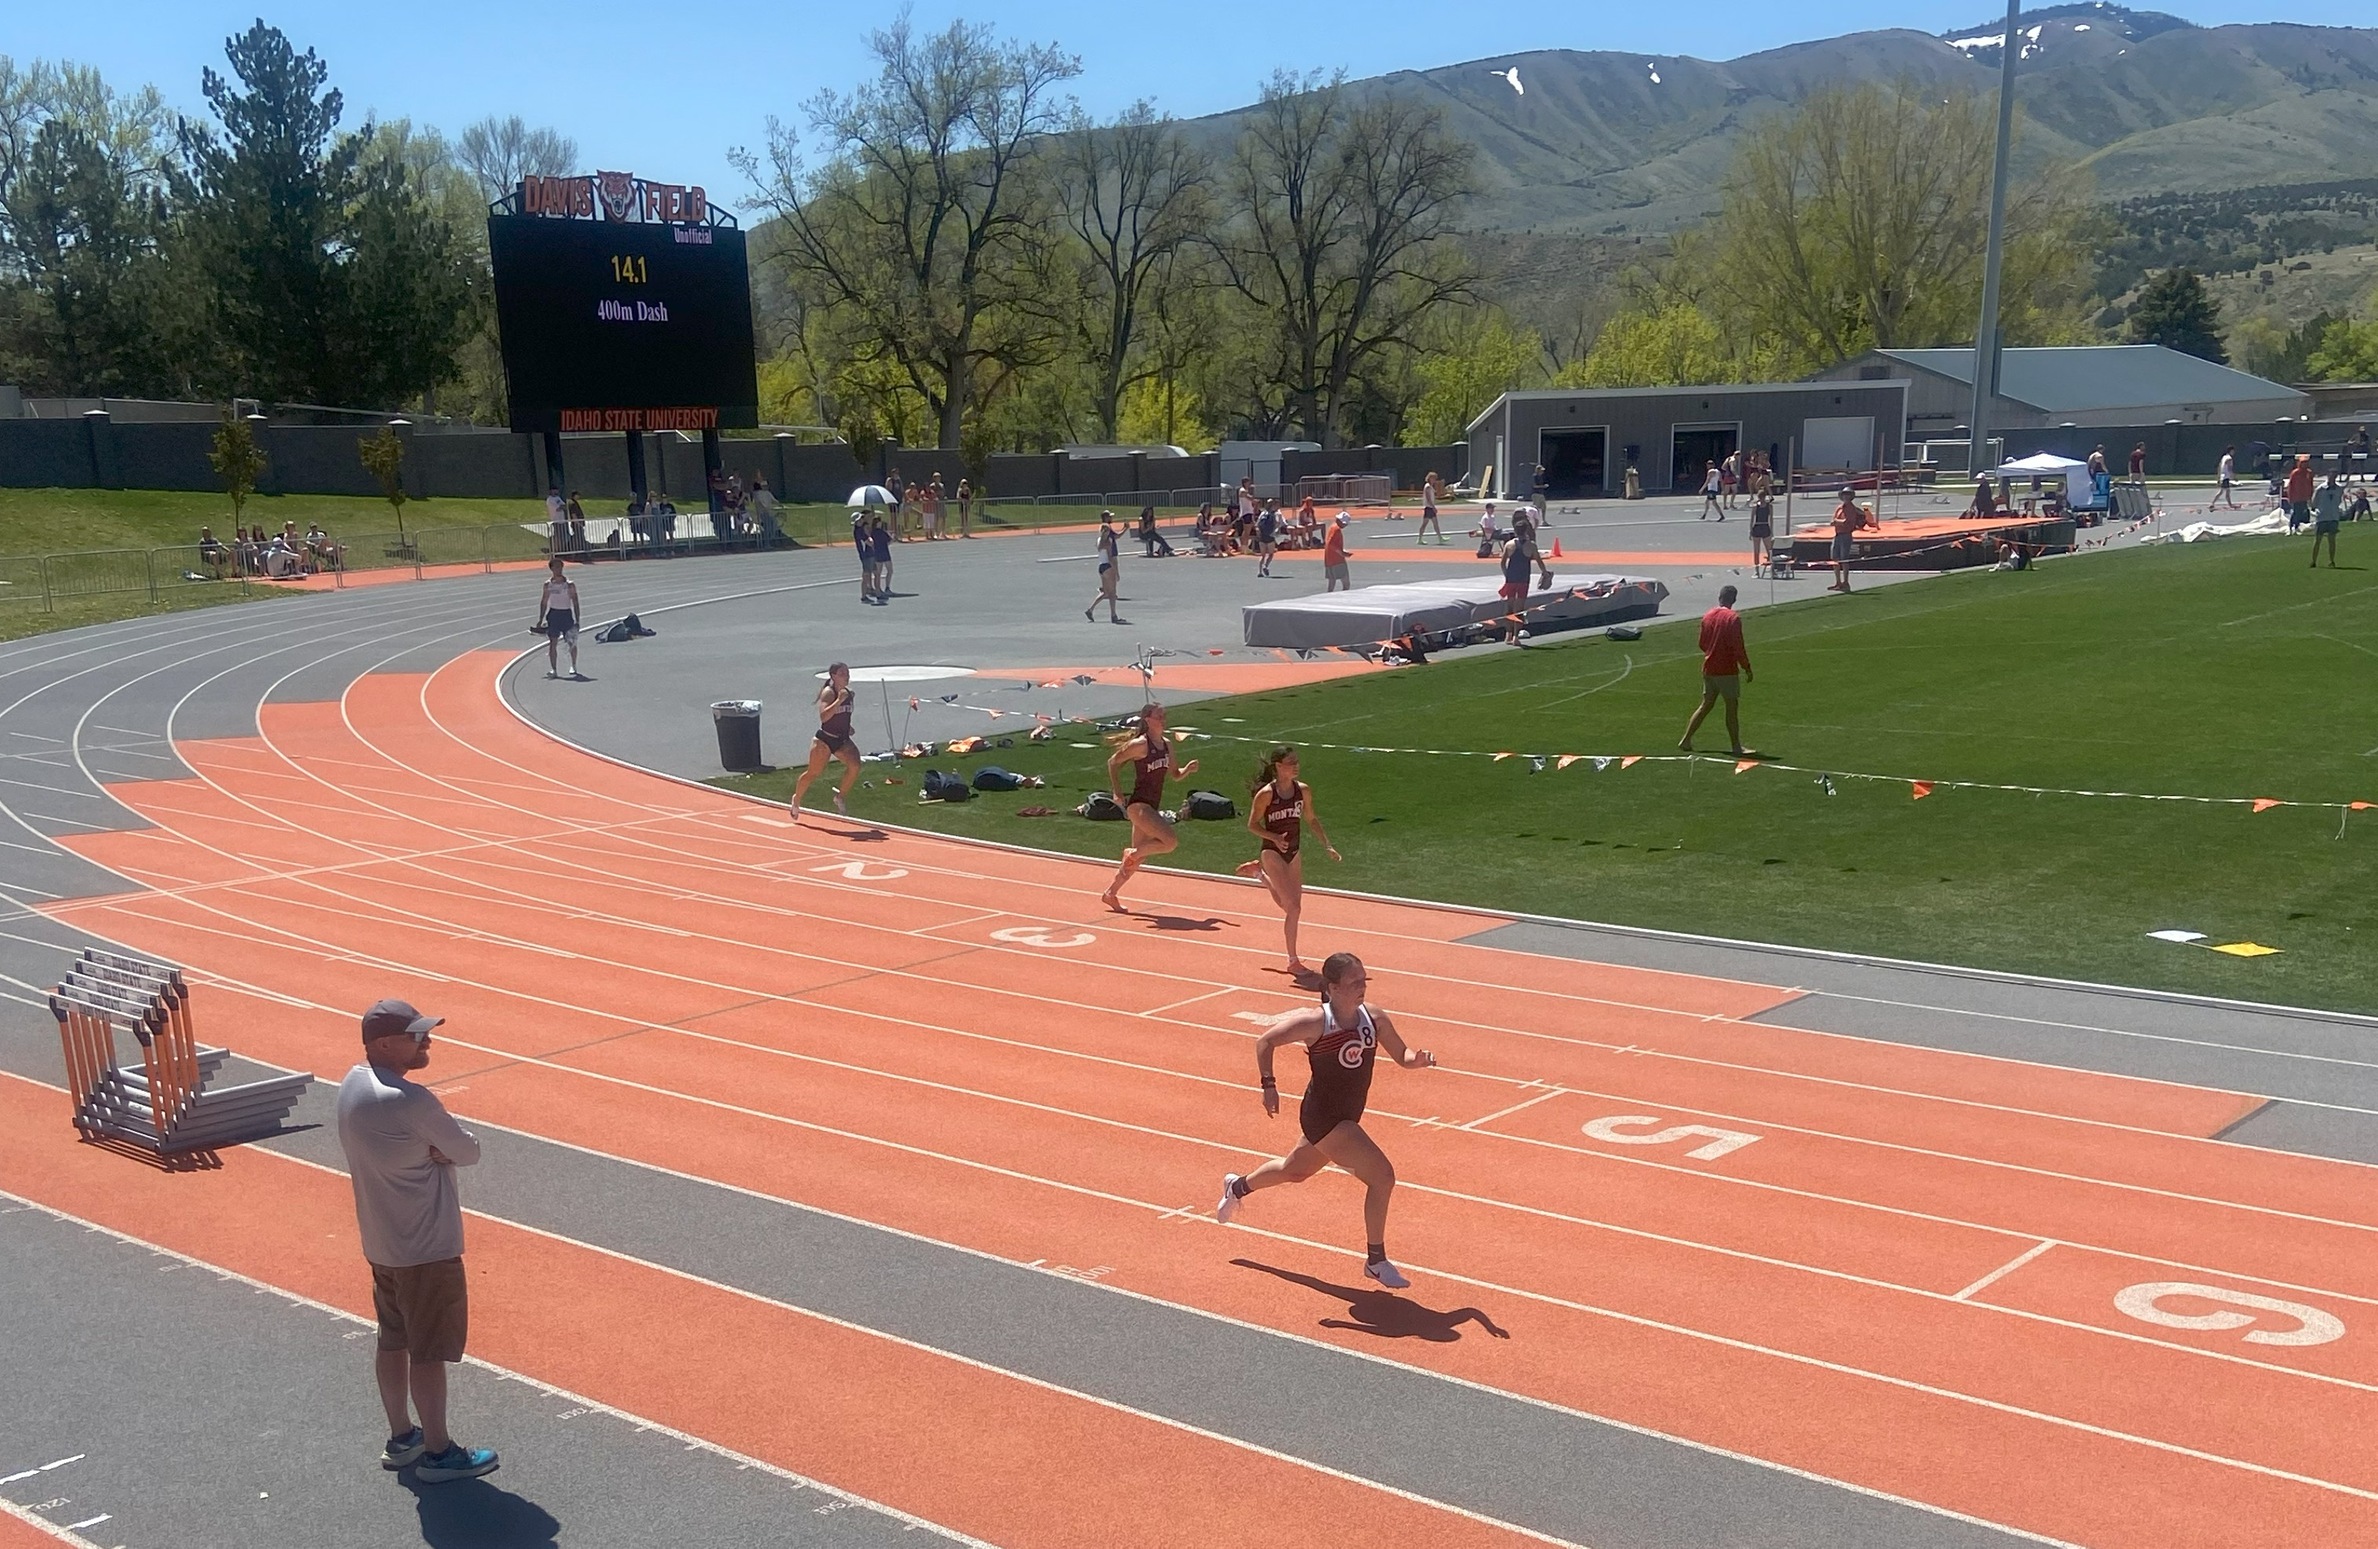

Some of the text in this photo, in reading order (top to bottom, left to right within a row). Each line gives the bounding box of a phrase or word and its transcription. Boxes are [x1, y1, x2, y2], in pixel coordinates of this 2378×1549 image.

[525, 175, 706, 222] DAVIS FIELD
[674, 227, 712, 245] Unofficial
[611, 255, 647, 283] 14.1
[597, 300, 669, 322] 400m Dash
[561, 408, 718, 431] IDAHO STATE UNIVERSITY
[808, 861, 909, 881] 2
[989, 926, 1097, 948] 3
[1362, 1026, 1373, 1047] 8
[1581, 1115, 1764, 1161] 5
[2113, 1281, 2346, 1346] 6
